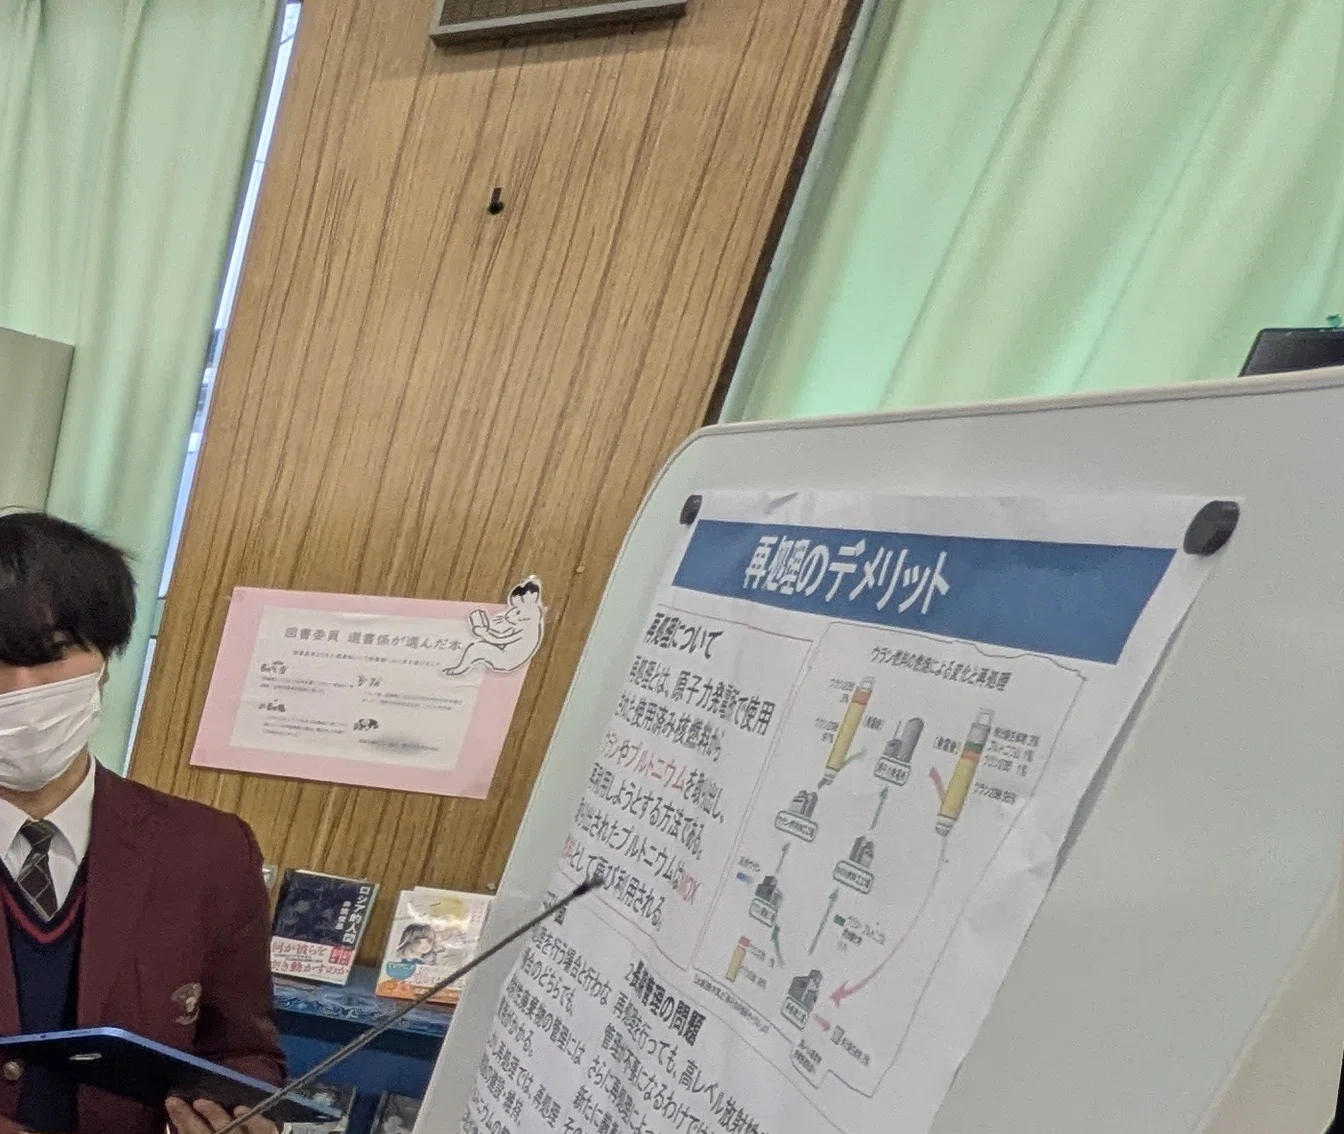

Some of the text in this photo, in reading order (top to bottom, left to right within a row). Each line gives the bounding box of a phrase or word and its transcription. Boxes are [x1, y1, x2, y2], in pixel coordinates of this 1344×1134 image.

[742, 536, 952, 615] 再処理のデメリット
[285, 626, 339, 644] 図書委員
[342, 886, 372, 944] ロシア的人間
